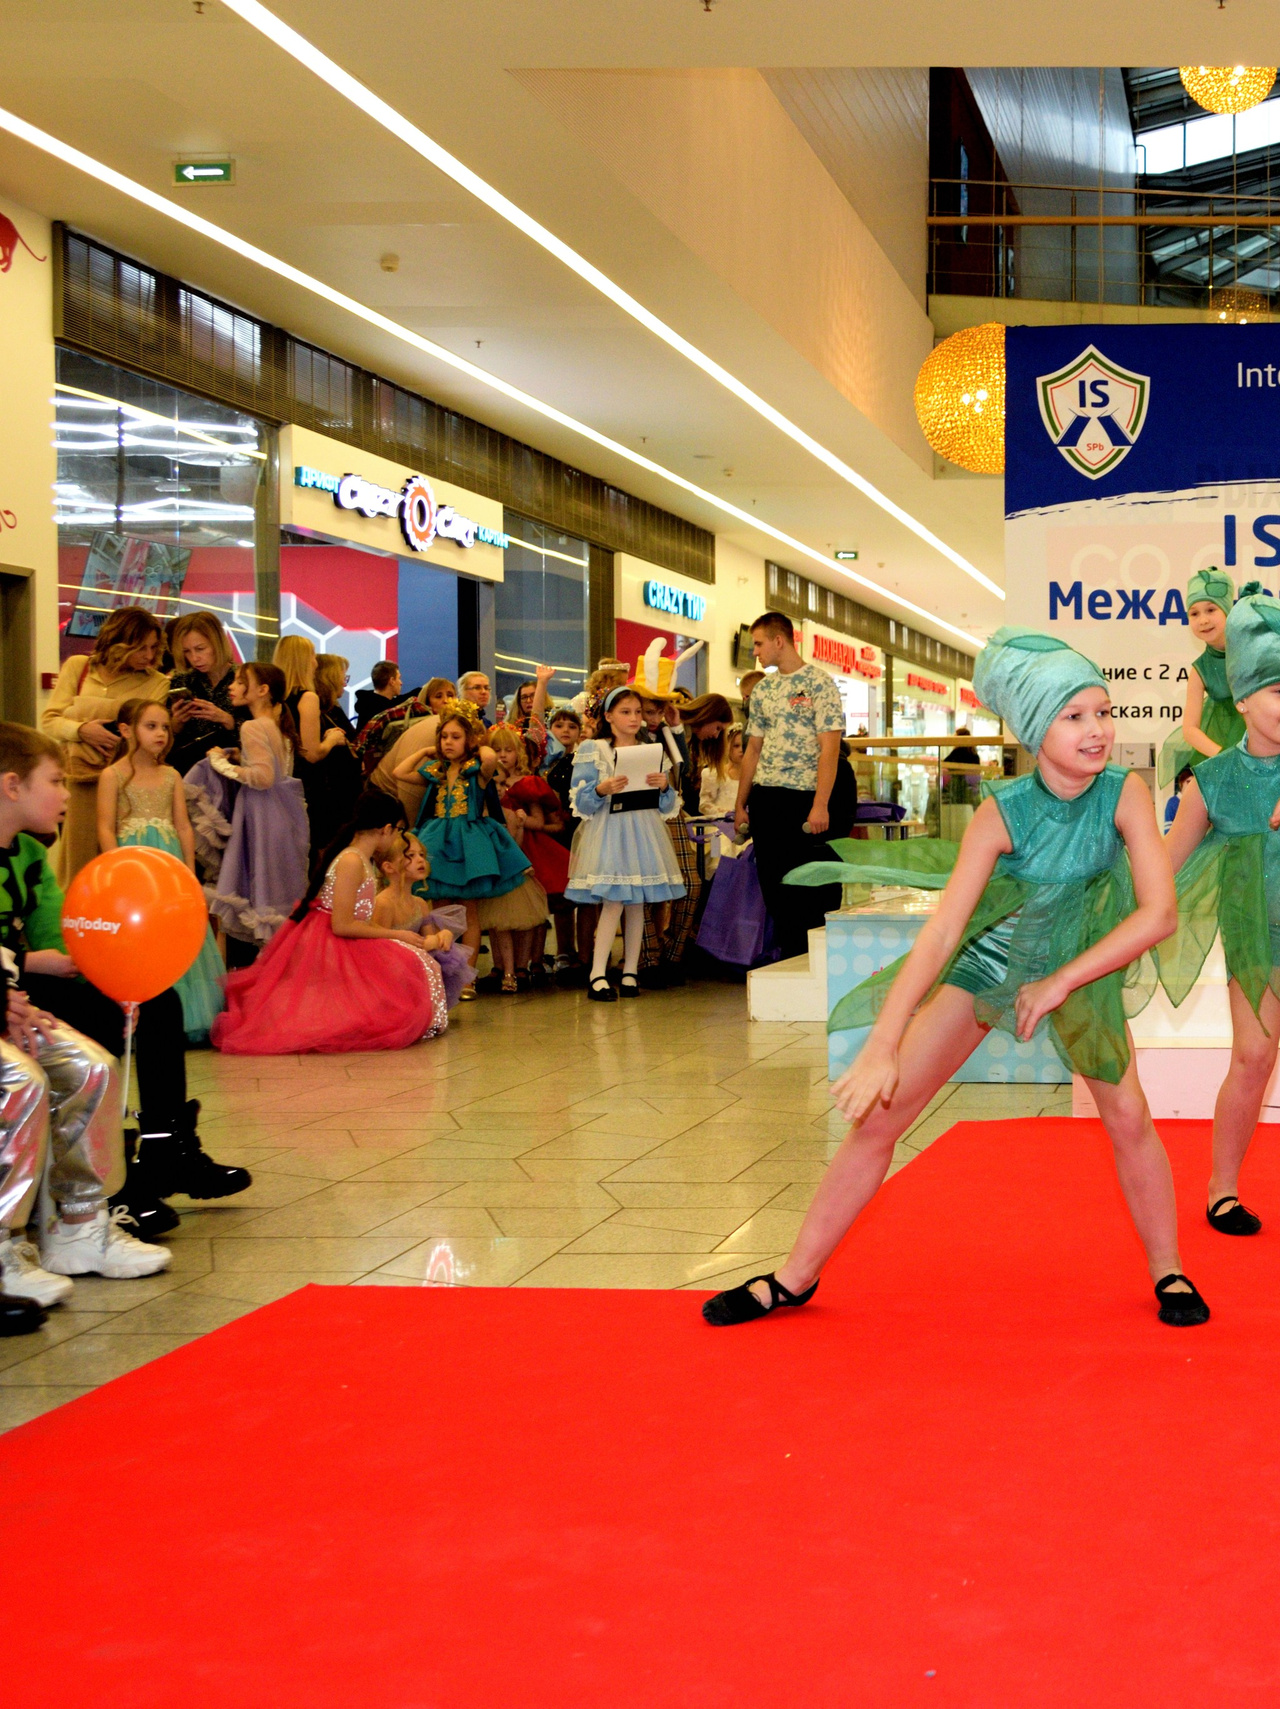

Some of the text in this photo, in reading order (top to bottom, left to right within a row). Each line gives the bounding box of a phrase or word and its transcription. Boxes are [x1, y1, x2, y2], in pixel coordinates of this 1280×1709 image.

[1078, 379, 1111, 409] IS
[1086, 442, 1105, 452] SPb
[645, 580, 684, 615] CRAZY
[1143, 667, 1152, 680] с
[1159, 663, 1170, 680] 2
